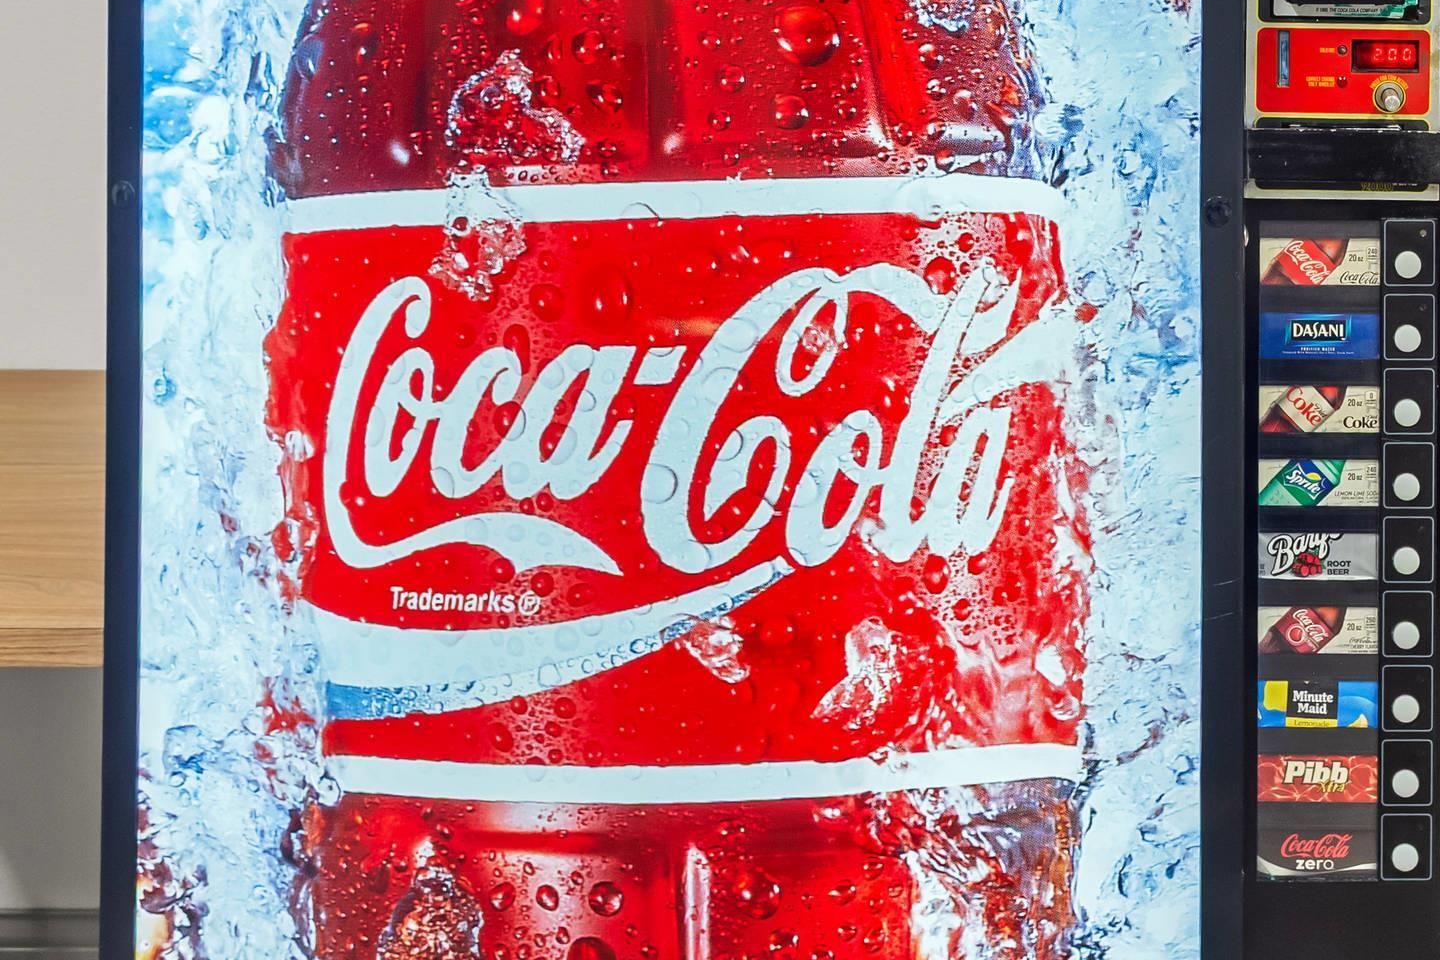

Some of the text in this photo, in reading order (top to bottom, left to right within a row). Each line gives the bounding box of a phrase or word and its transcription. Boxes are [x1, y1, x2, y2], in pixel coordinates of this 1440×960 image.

[1293, 322, 1344, 339] DASANI
[1286, 385, 1322, 426] Coke
[323, 262, 1080, 574] Coca-Cola
[1343, 416, 1378, 428] Coke
[1286, 469, 1322, 495] Sprite
[1292, 690, 1333, 703] Minute
[1297, 702, 1328, 714] Maid
[1284, 760, 1348, 784] Pibb
[1281, 833, 1353, 858] Coca-Cola
[1296, 859, 1334, 870] zero
